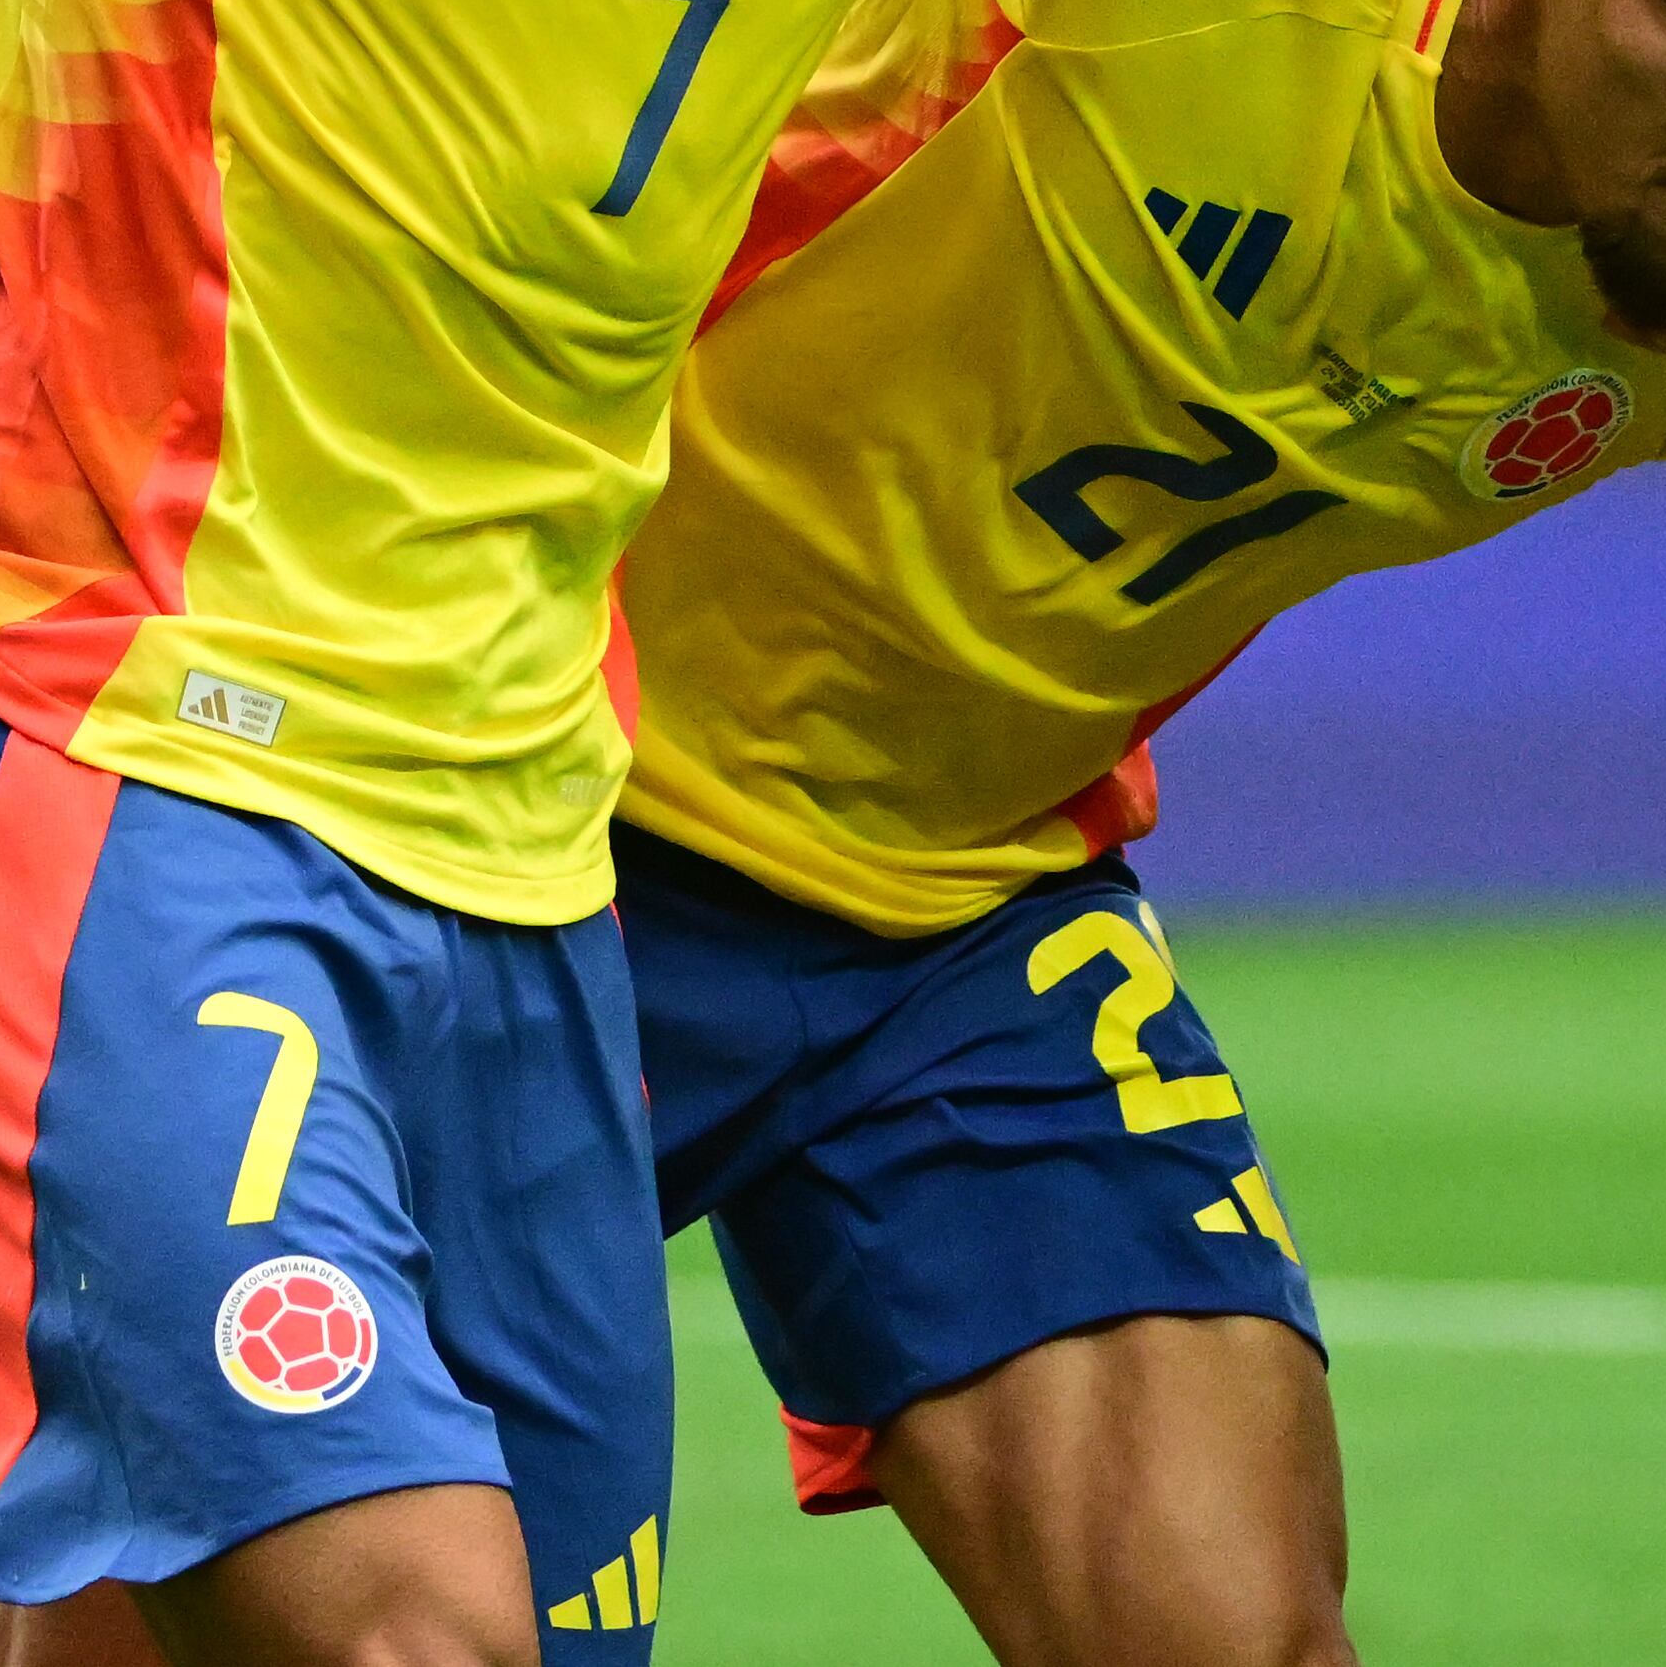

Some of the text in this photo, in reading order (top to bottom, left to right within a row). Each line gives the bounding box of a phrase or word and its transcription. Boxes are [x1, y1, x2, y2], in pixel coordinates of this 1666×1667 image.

[1013, 400, 1349, 606] 21
[197, 990, 319, 1226] 7
[1027, 900, 1244, 1134] 2
[243, 1261, 317, 1291] COLOMBIANA
[318, 1267, 333, 1281] DE
